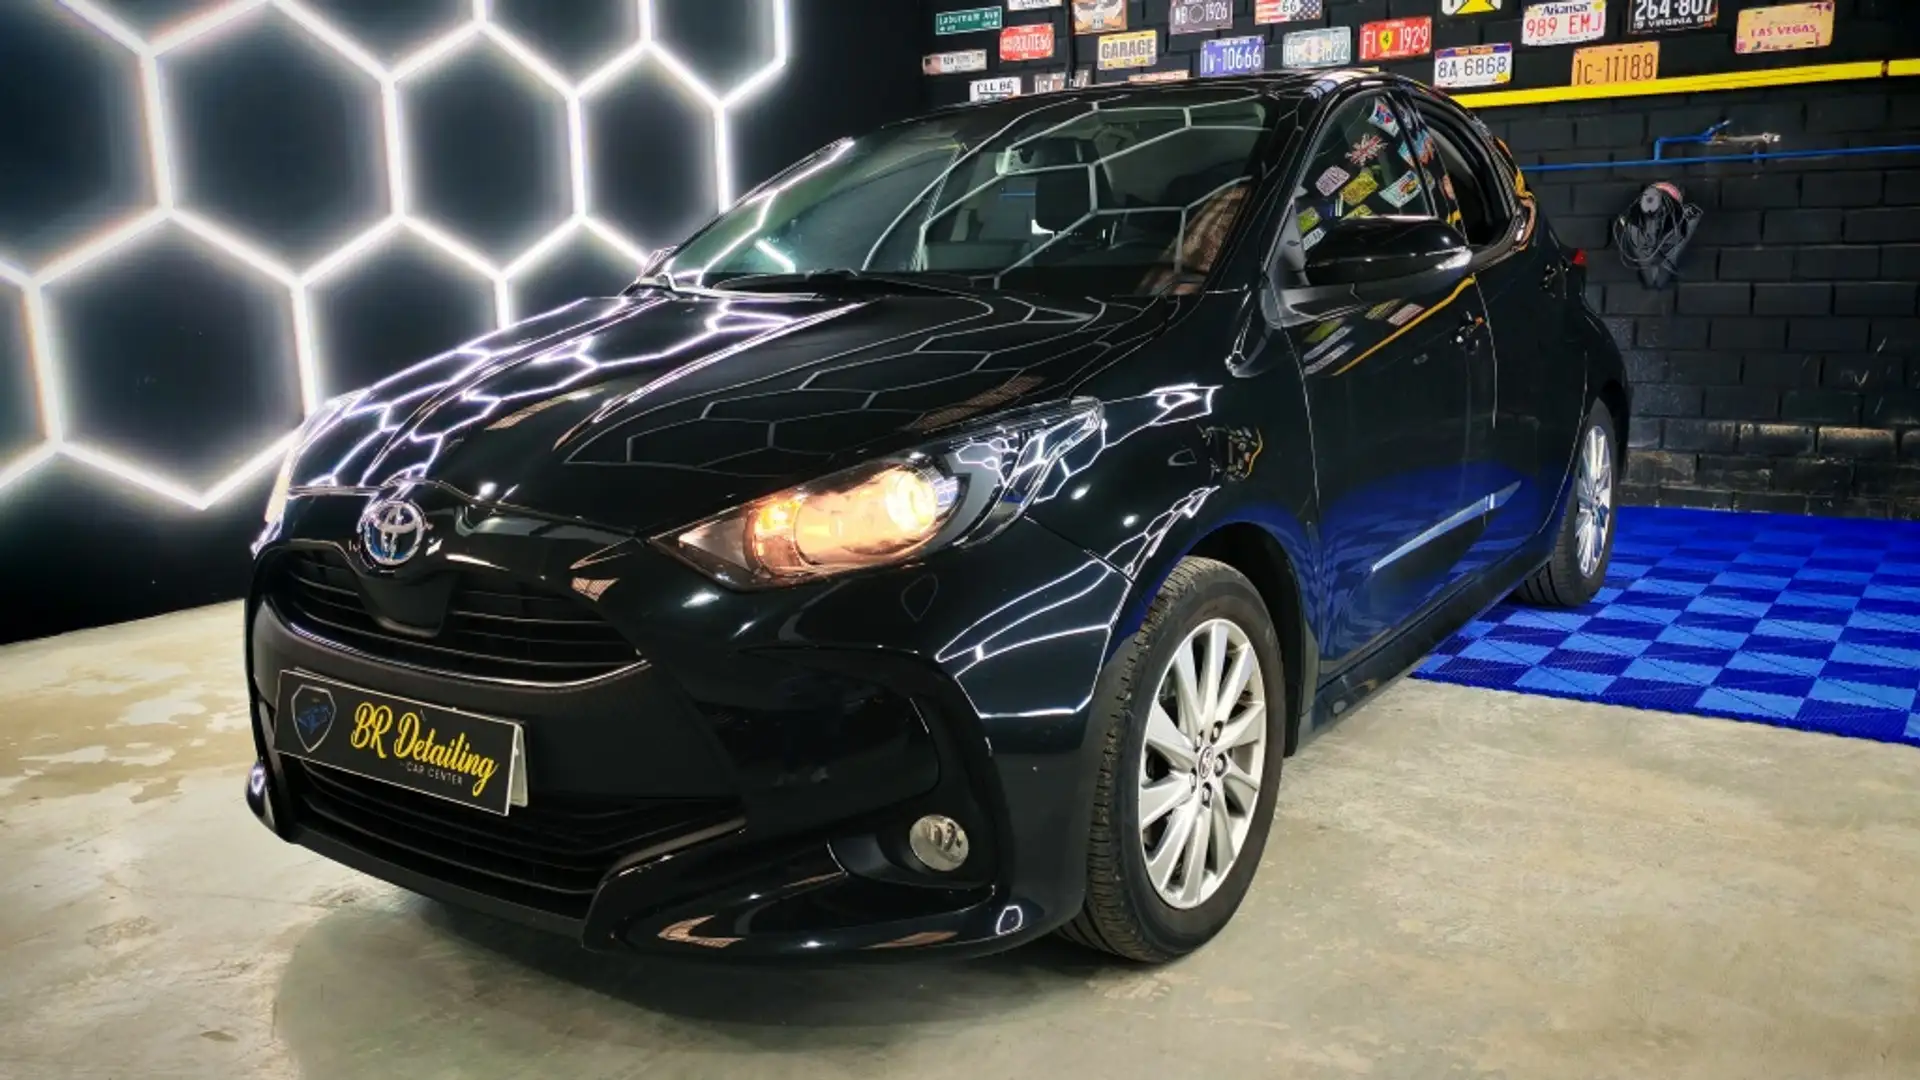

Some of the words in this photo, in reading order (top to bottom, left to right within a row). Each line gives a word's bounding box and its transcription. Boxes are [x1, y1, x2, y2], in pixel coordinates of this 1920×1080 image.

[983, 10, 999, 20] Ave
[1541, 3, 1588, 16] Arkansas
[1526, 17, 1557, 38] 989
[1568, 12, 1602, 35] EMJ
[1648, 17, 1693, 28] VIRGINIA
[1751, 27, 1773, 38] LAS
[1777, 24, 1817, 35] VEGAS
[1102, 38, 1154, 59] GARAGE
[1400, 26, 1428, 50] 1929
[1438, 56, 1507, 79] 8A-6868
[350, 701, 393, 759] BR
[393, 711, 498, 797] Detailing
[406, 762, 425, 775] CAR
[429, 768, 463, 786] CENTER
